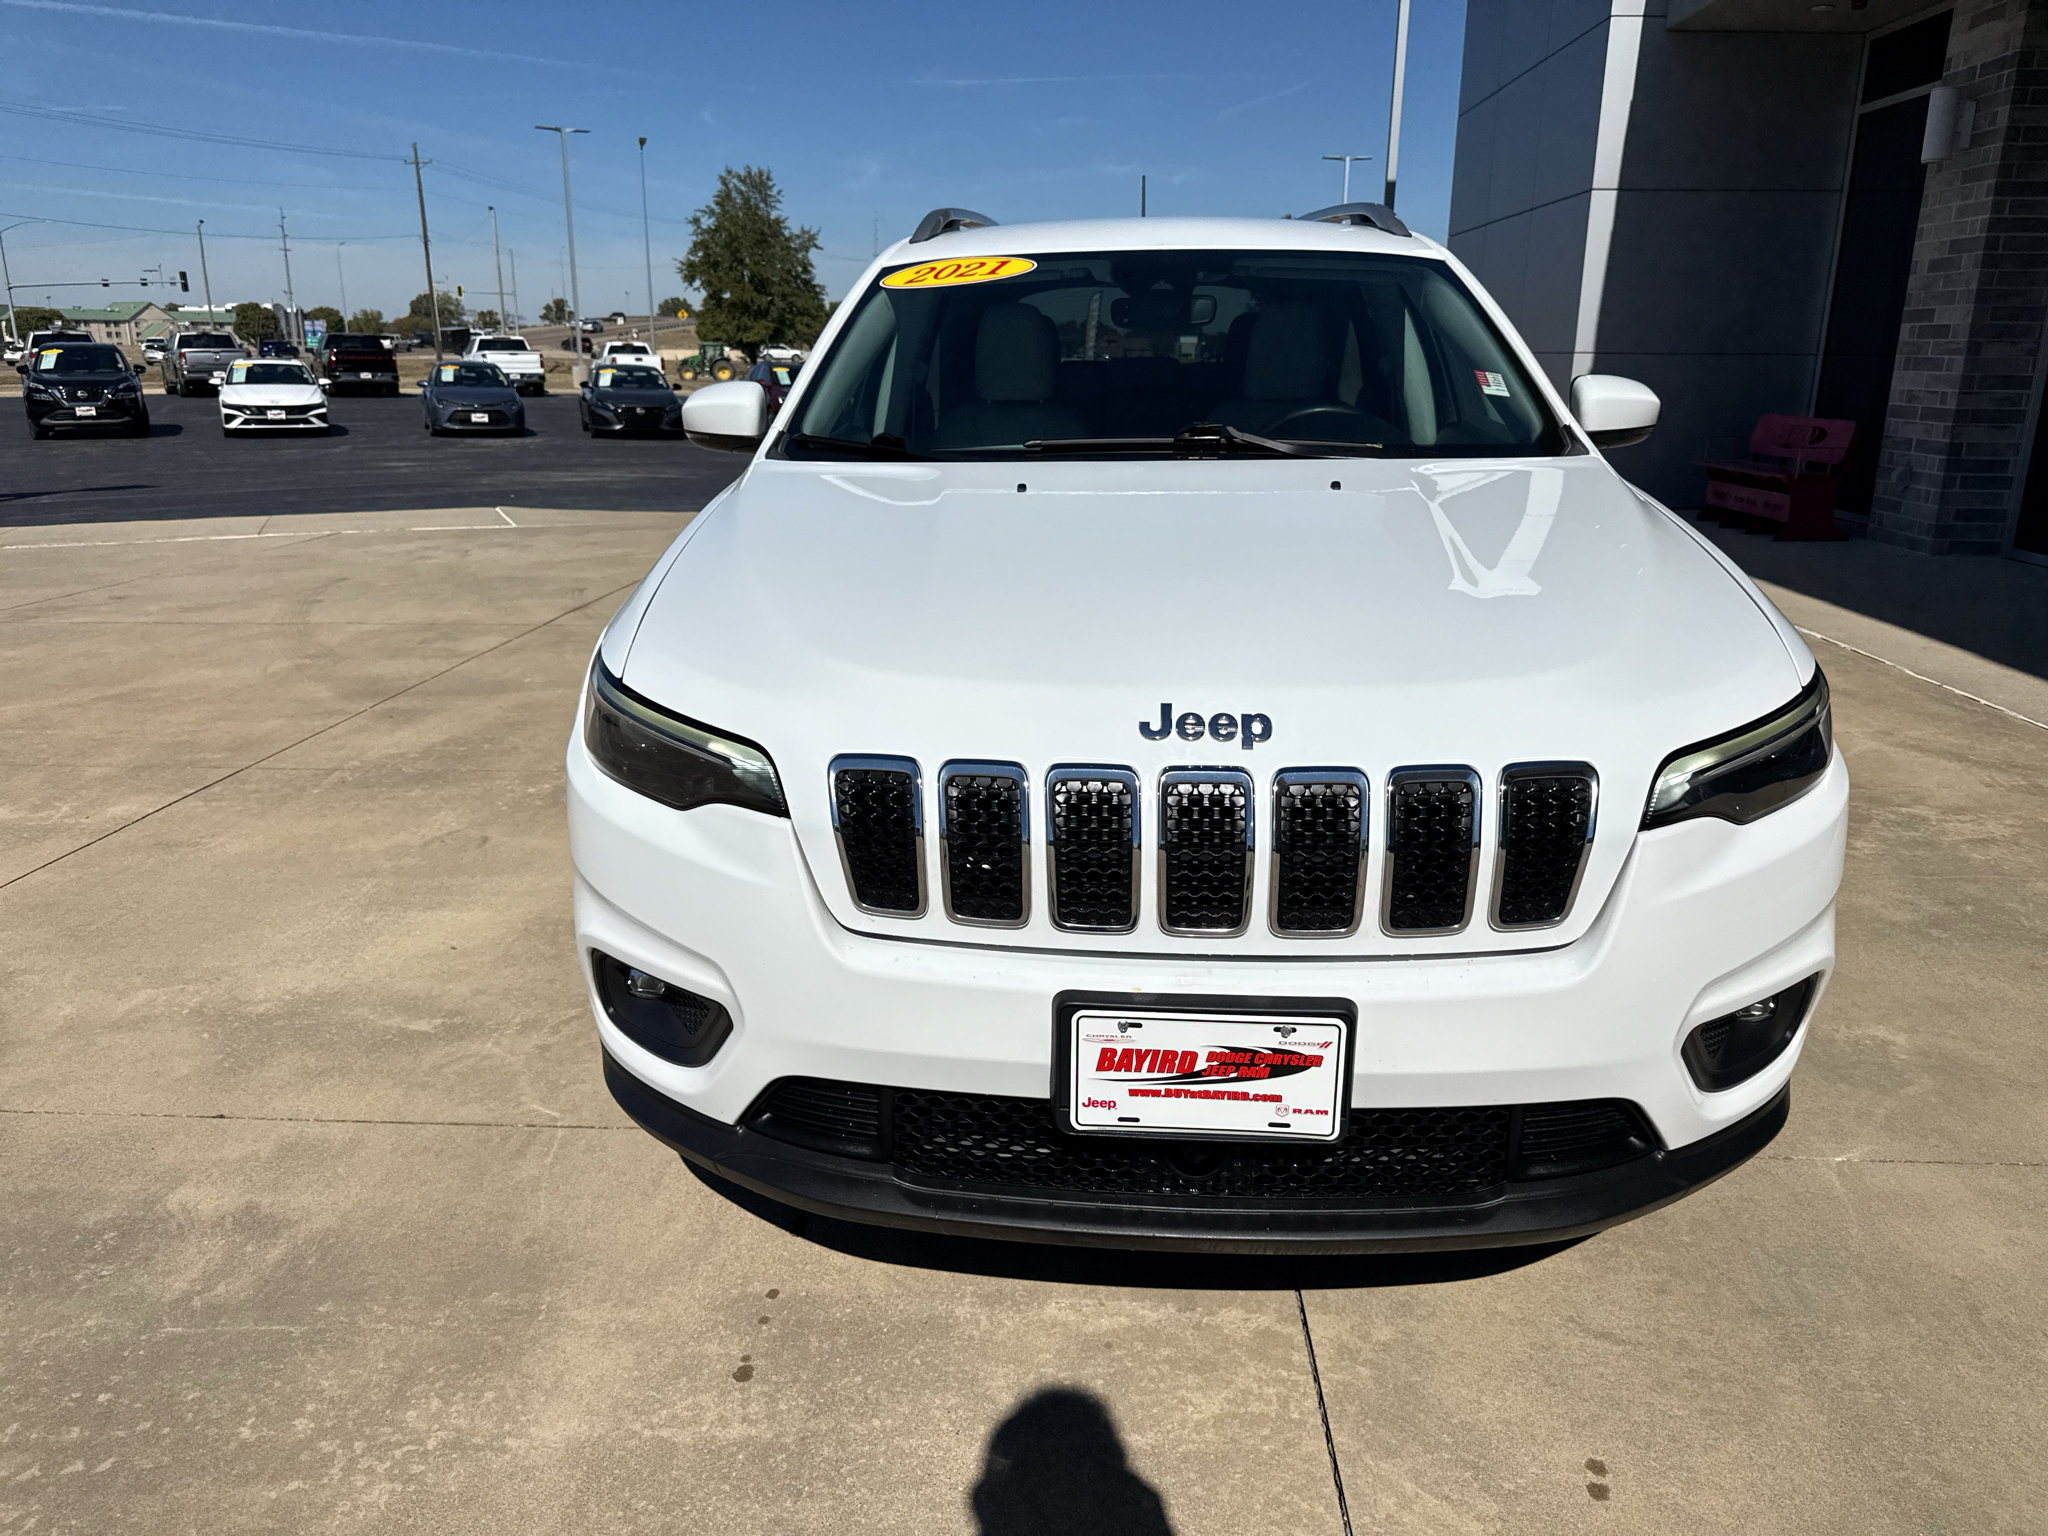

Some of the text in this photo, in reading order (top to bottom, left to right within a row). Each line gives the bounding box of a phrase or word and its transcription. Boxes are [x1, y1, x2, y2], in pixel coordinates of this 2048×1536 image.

[904, 260, 1011, 285] 2021
[1138, 702, 1273, 750] Jeep
[1095, 1047, 1199, 1074] BAYIRD
[1205, 1051, 1324, 1068] DODGE CHRYSLER
[1201, 1064, 1271, 1079] JEEP RAM
[1128, 1087, 1283, 1103] www.BUYatBAYIRD.com
[1082, 1097, 1117, 1110] Jeep
[1292, 1108, 1329, 1116] RAM
